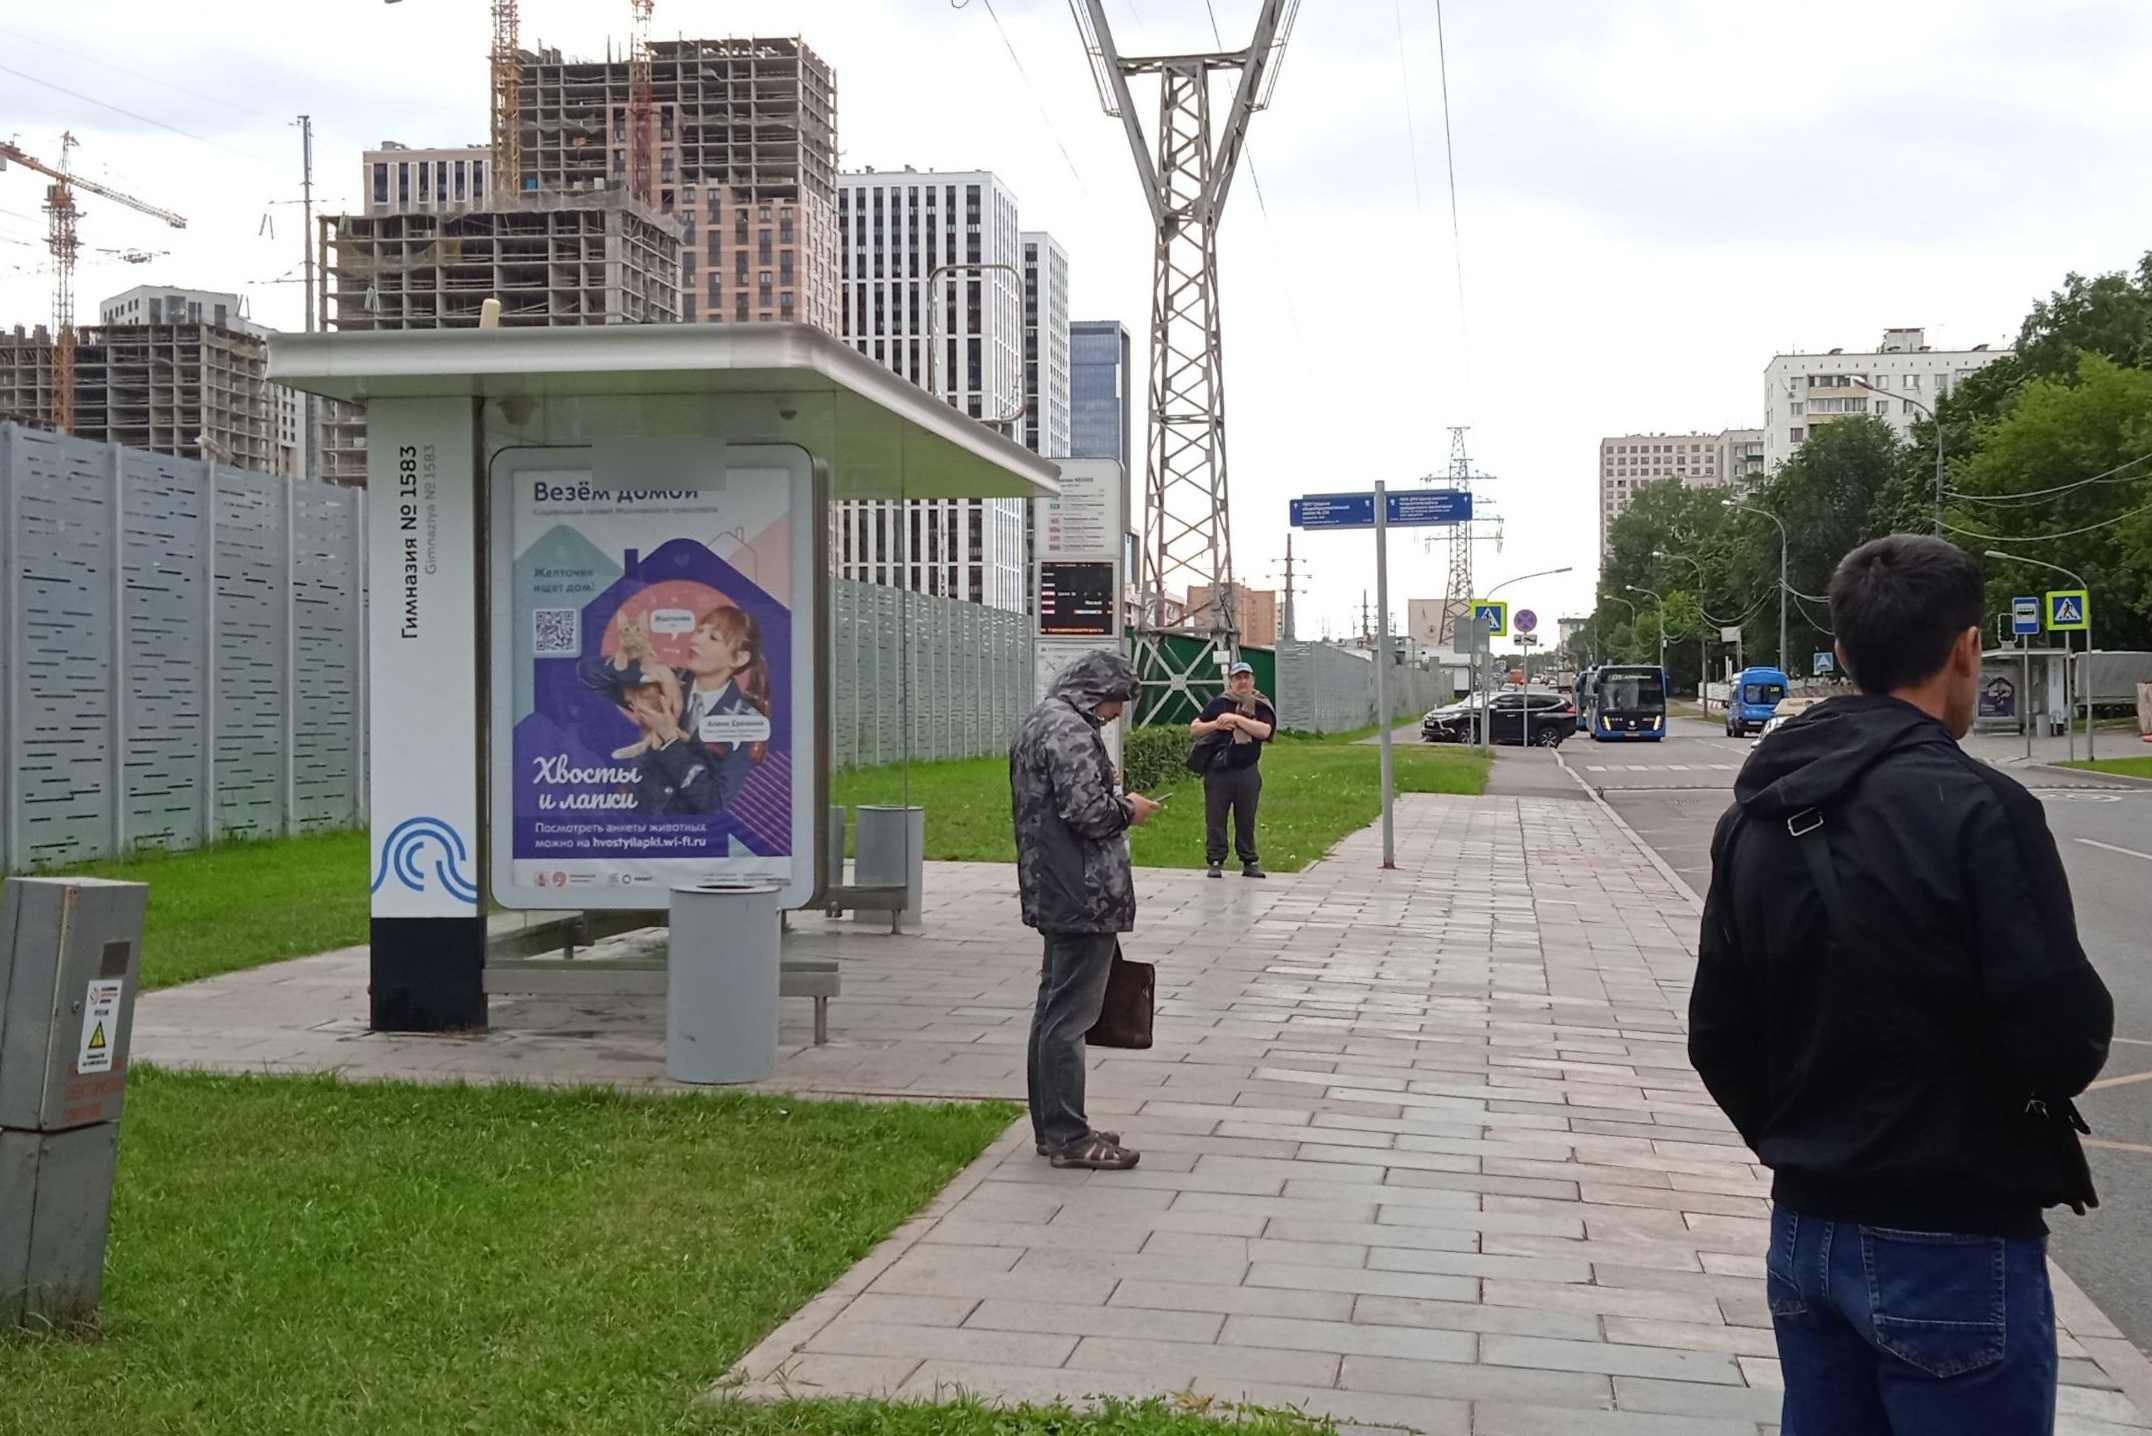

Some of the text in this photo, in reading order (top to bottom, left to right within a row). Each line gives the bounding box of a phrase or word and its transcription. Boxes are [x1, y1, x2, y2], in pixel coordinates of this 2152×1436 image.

[534, 481, 611, 502] Везём
[423, 444, 440, 575] Gimnaziya № 1583
[399, 445, 418, 639] Гимназия № 1583
[533, 566, 594, 579] Желточек
[533, 582, 563, 595] ищет
[532, 755, 643, 785] Хвосты
[539, 793, 639, 811] и лапки
[535, 821, 707, 836] Посмотреть анкеты животных
[534, 838, 574, 848] можно
[576, 838, 591, 848] на
